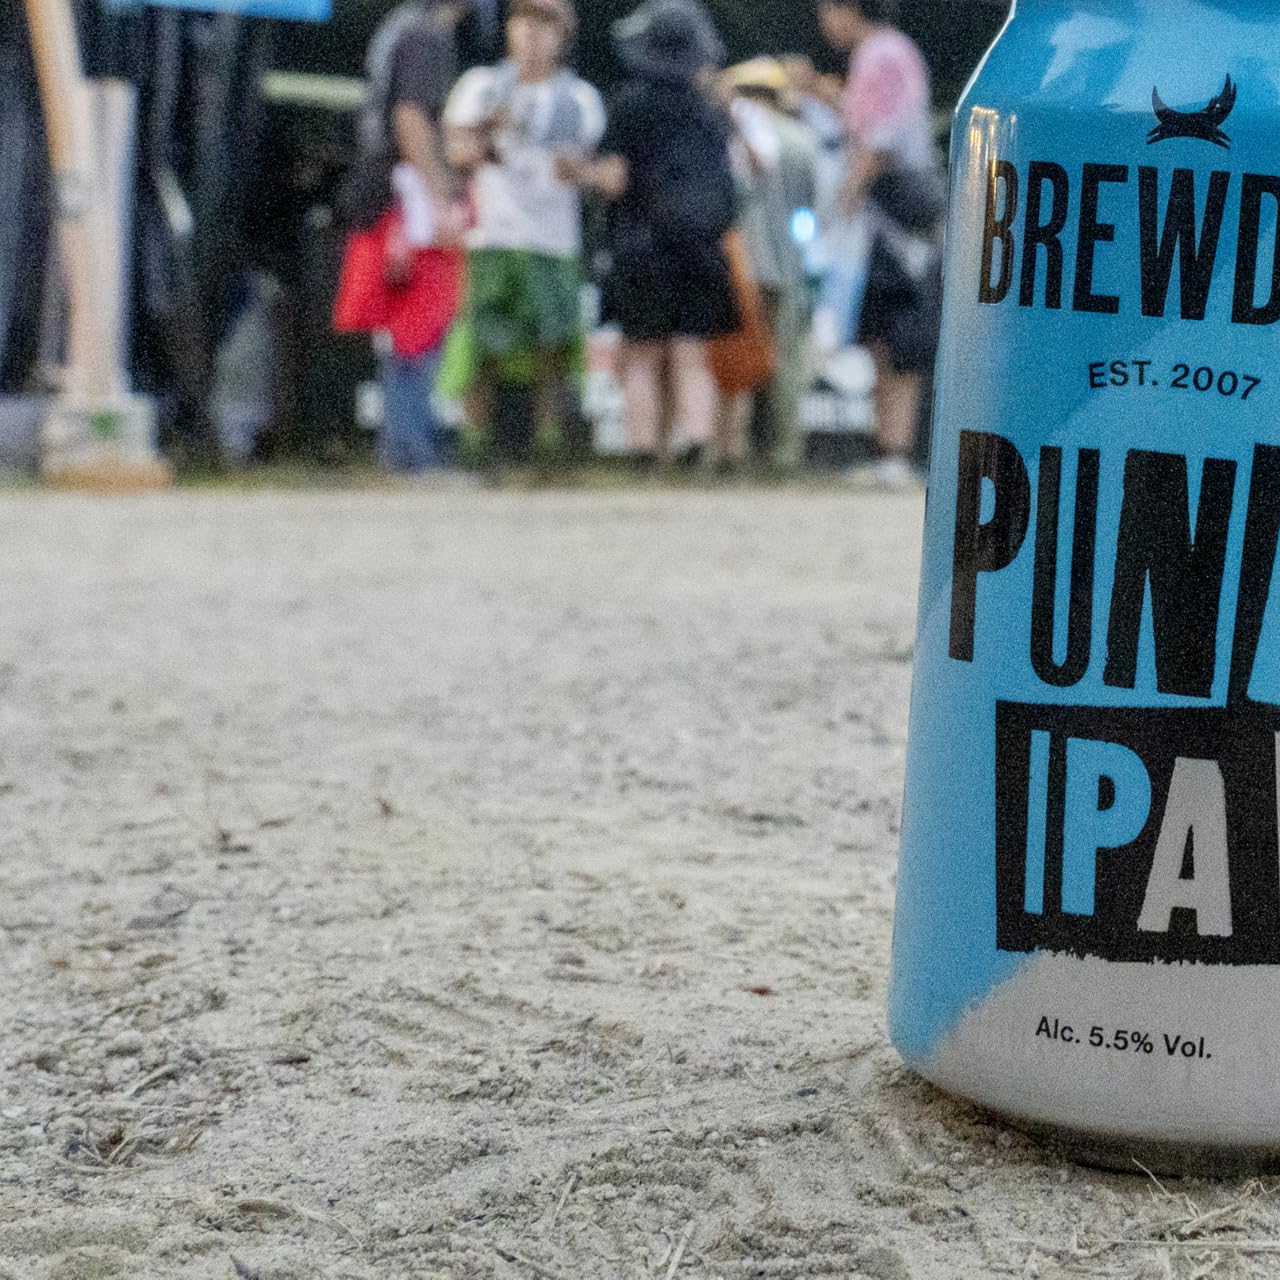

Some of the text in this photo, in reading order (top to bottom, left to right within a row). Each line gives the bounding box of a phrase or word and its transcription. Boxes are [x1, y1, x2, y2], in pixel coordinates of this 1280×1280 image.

[1088, 360, 1261, 400] EST. 2007
[1023, 728, 1234, 938] IPA
[1035, 1016, 1212, 1059] Alc. 5.5% Vol.
